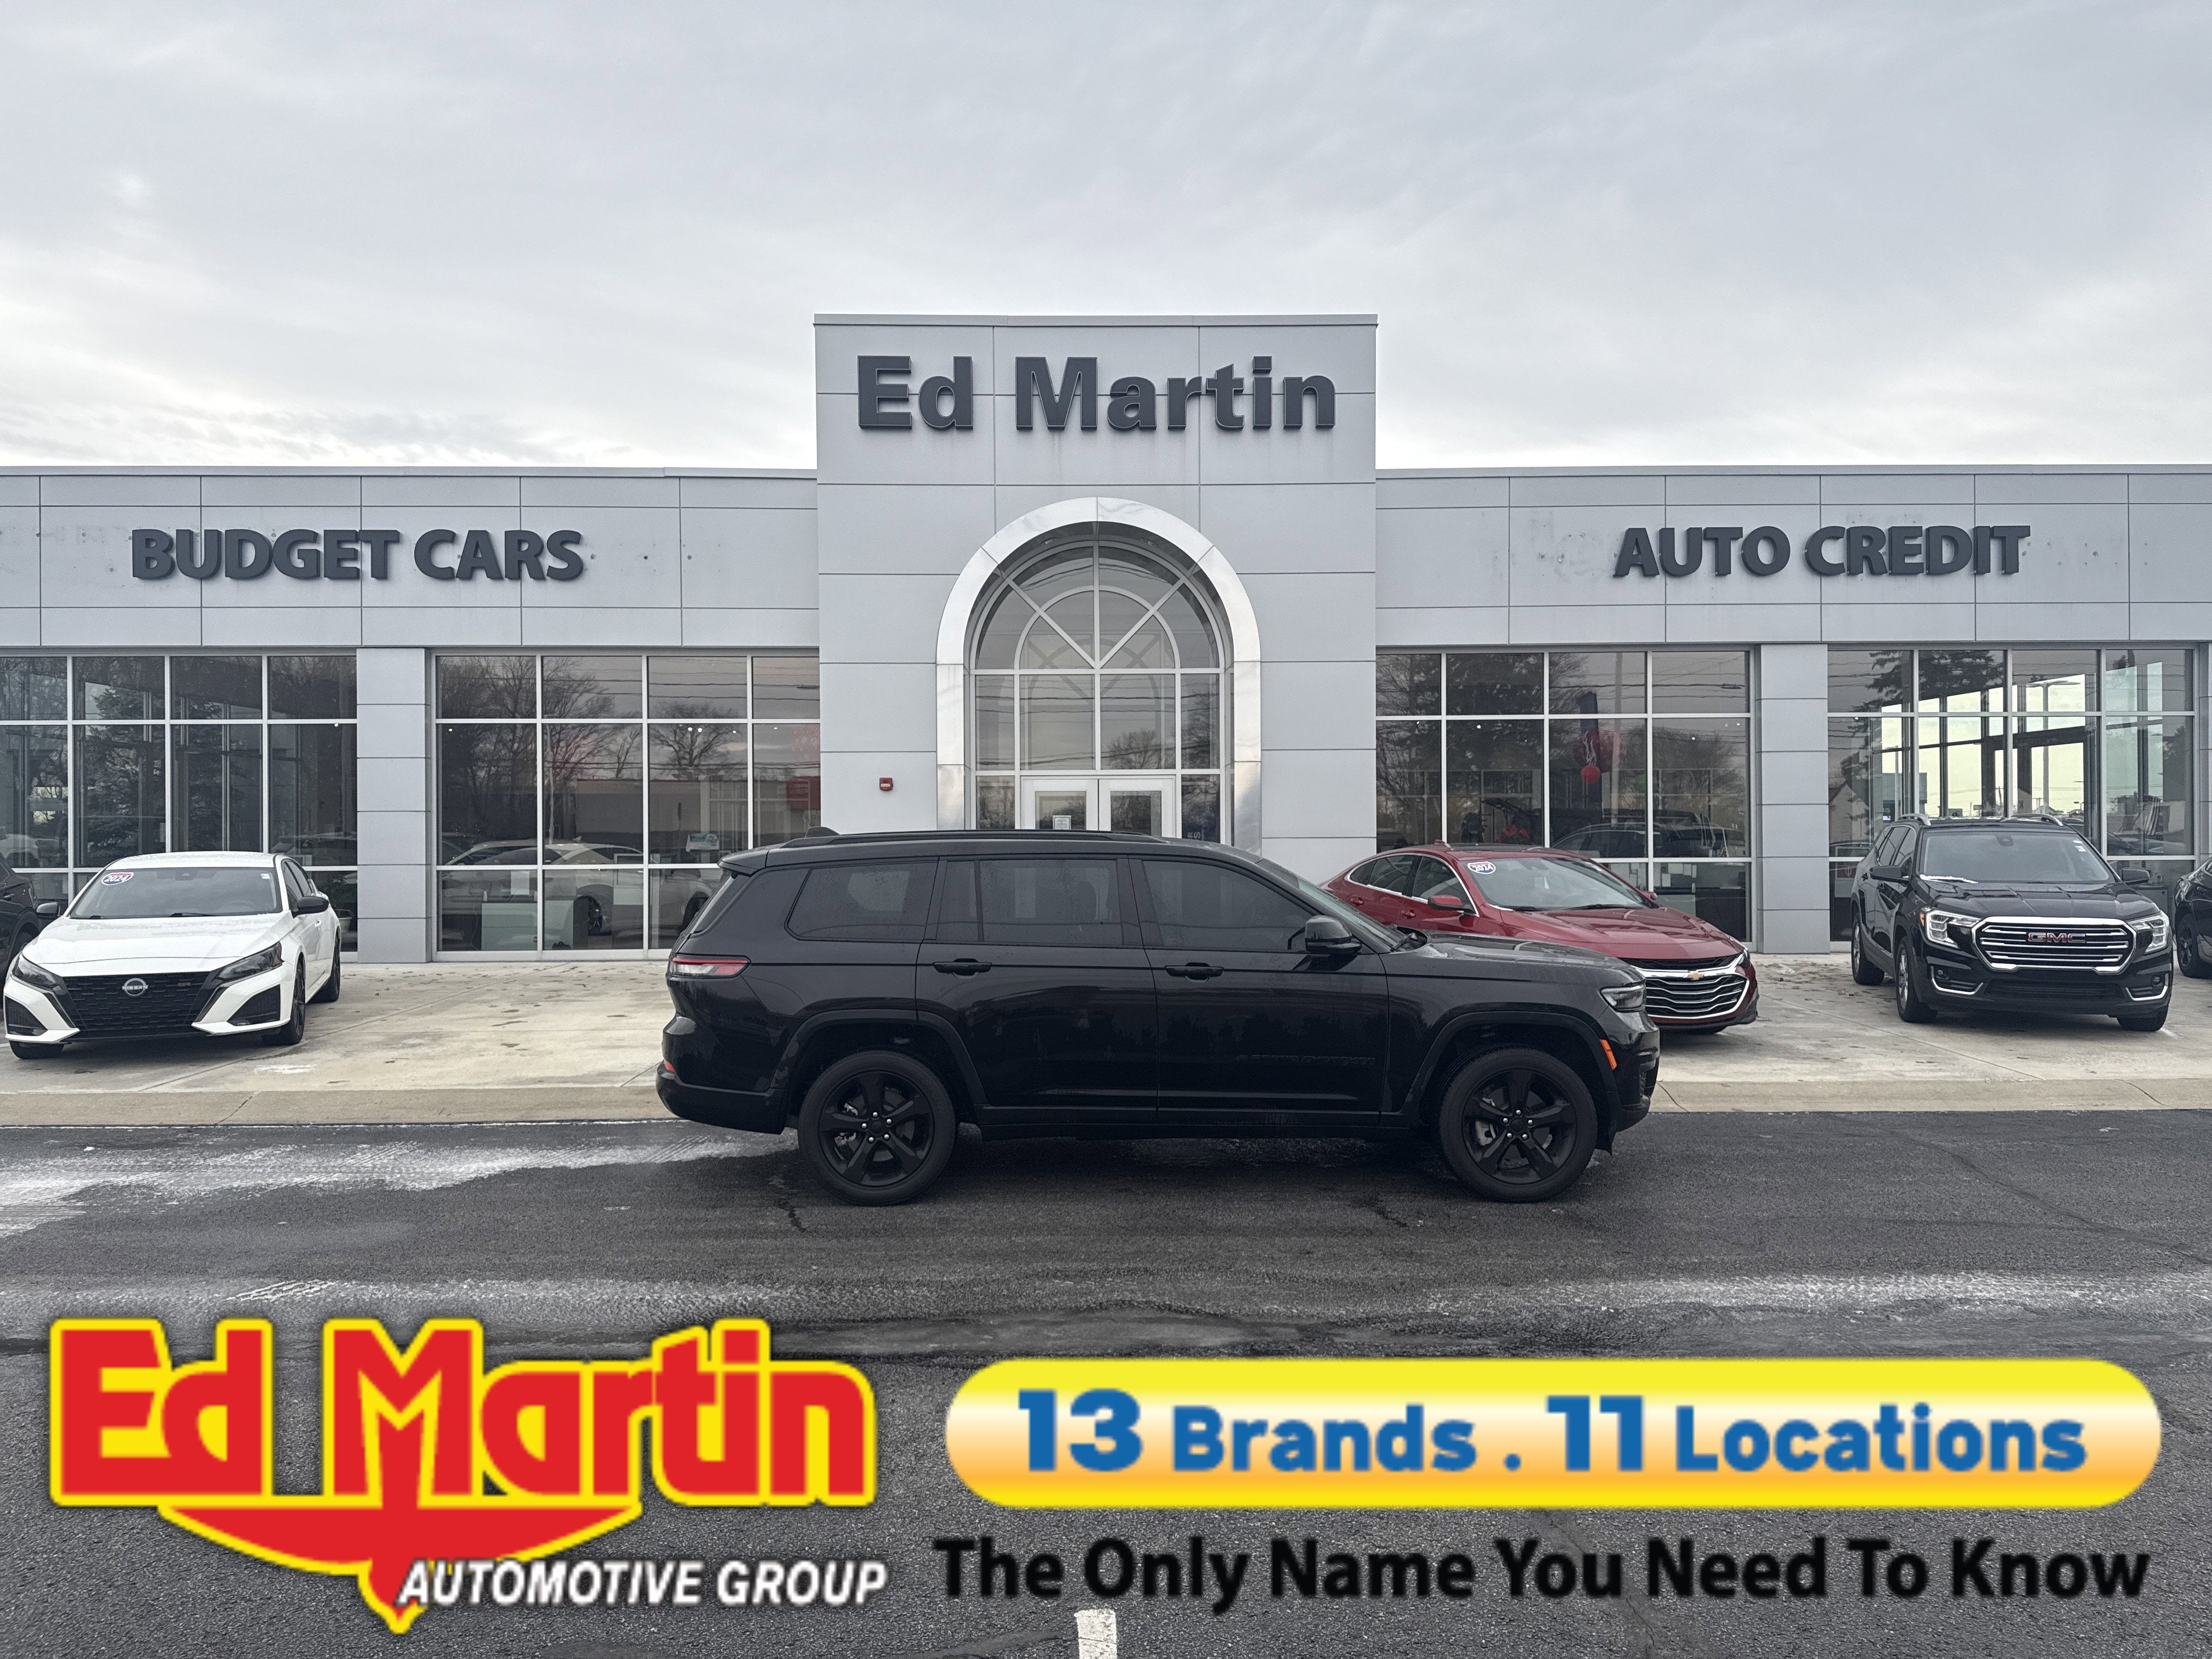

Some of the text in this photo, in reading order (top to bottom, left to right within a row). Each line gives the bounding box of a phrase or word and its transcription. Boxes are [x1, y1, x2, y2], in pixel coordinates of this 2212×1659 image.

[857, 354, 1336, 432] Ed Martin
[131, 529, 585, 582] BUDGET CARS
[1613, 525, 2031, 578] AUTO CREDIT
[2028, 932, 2085, 944] GMC
